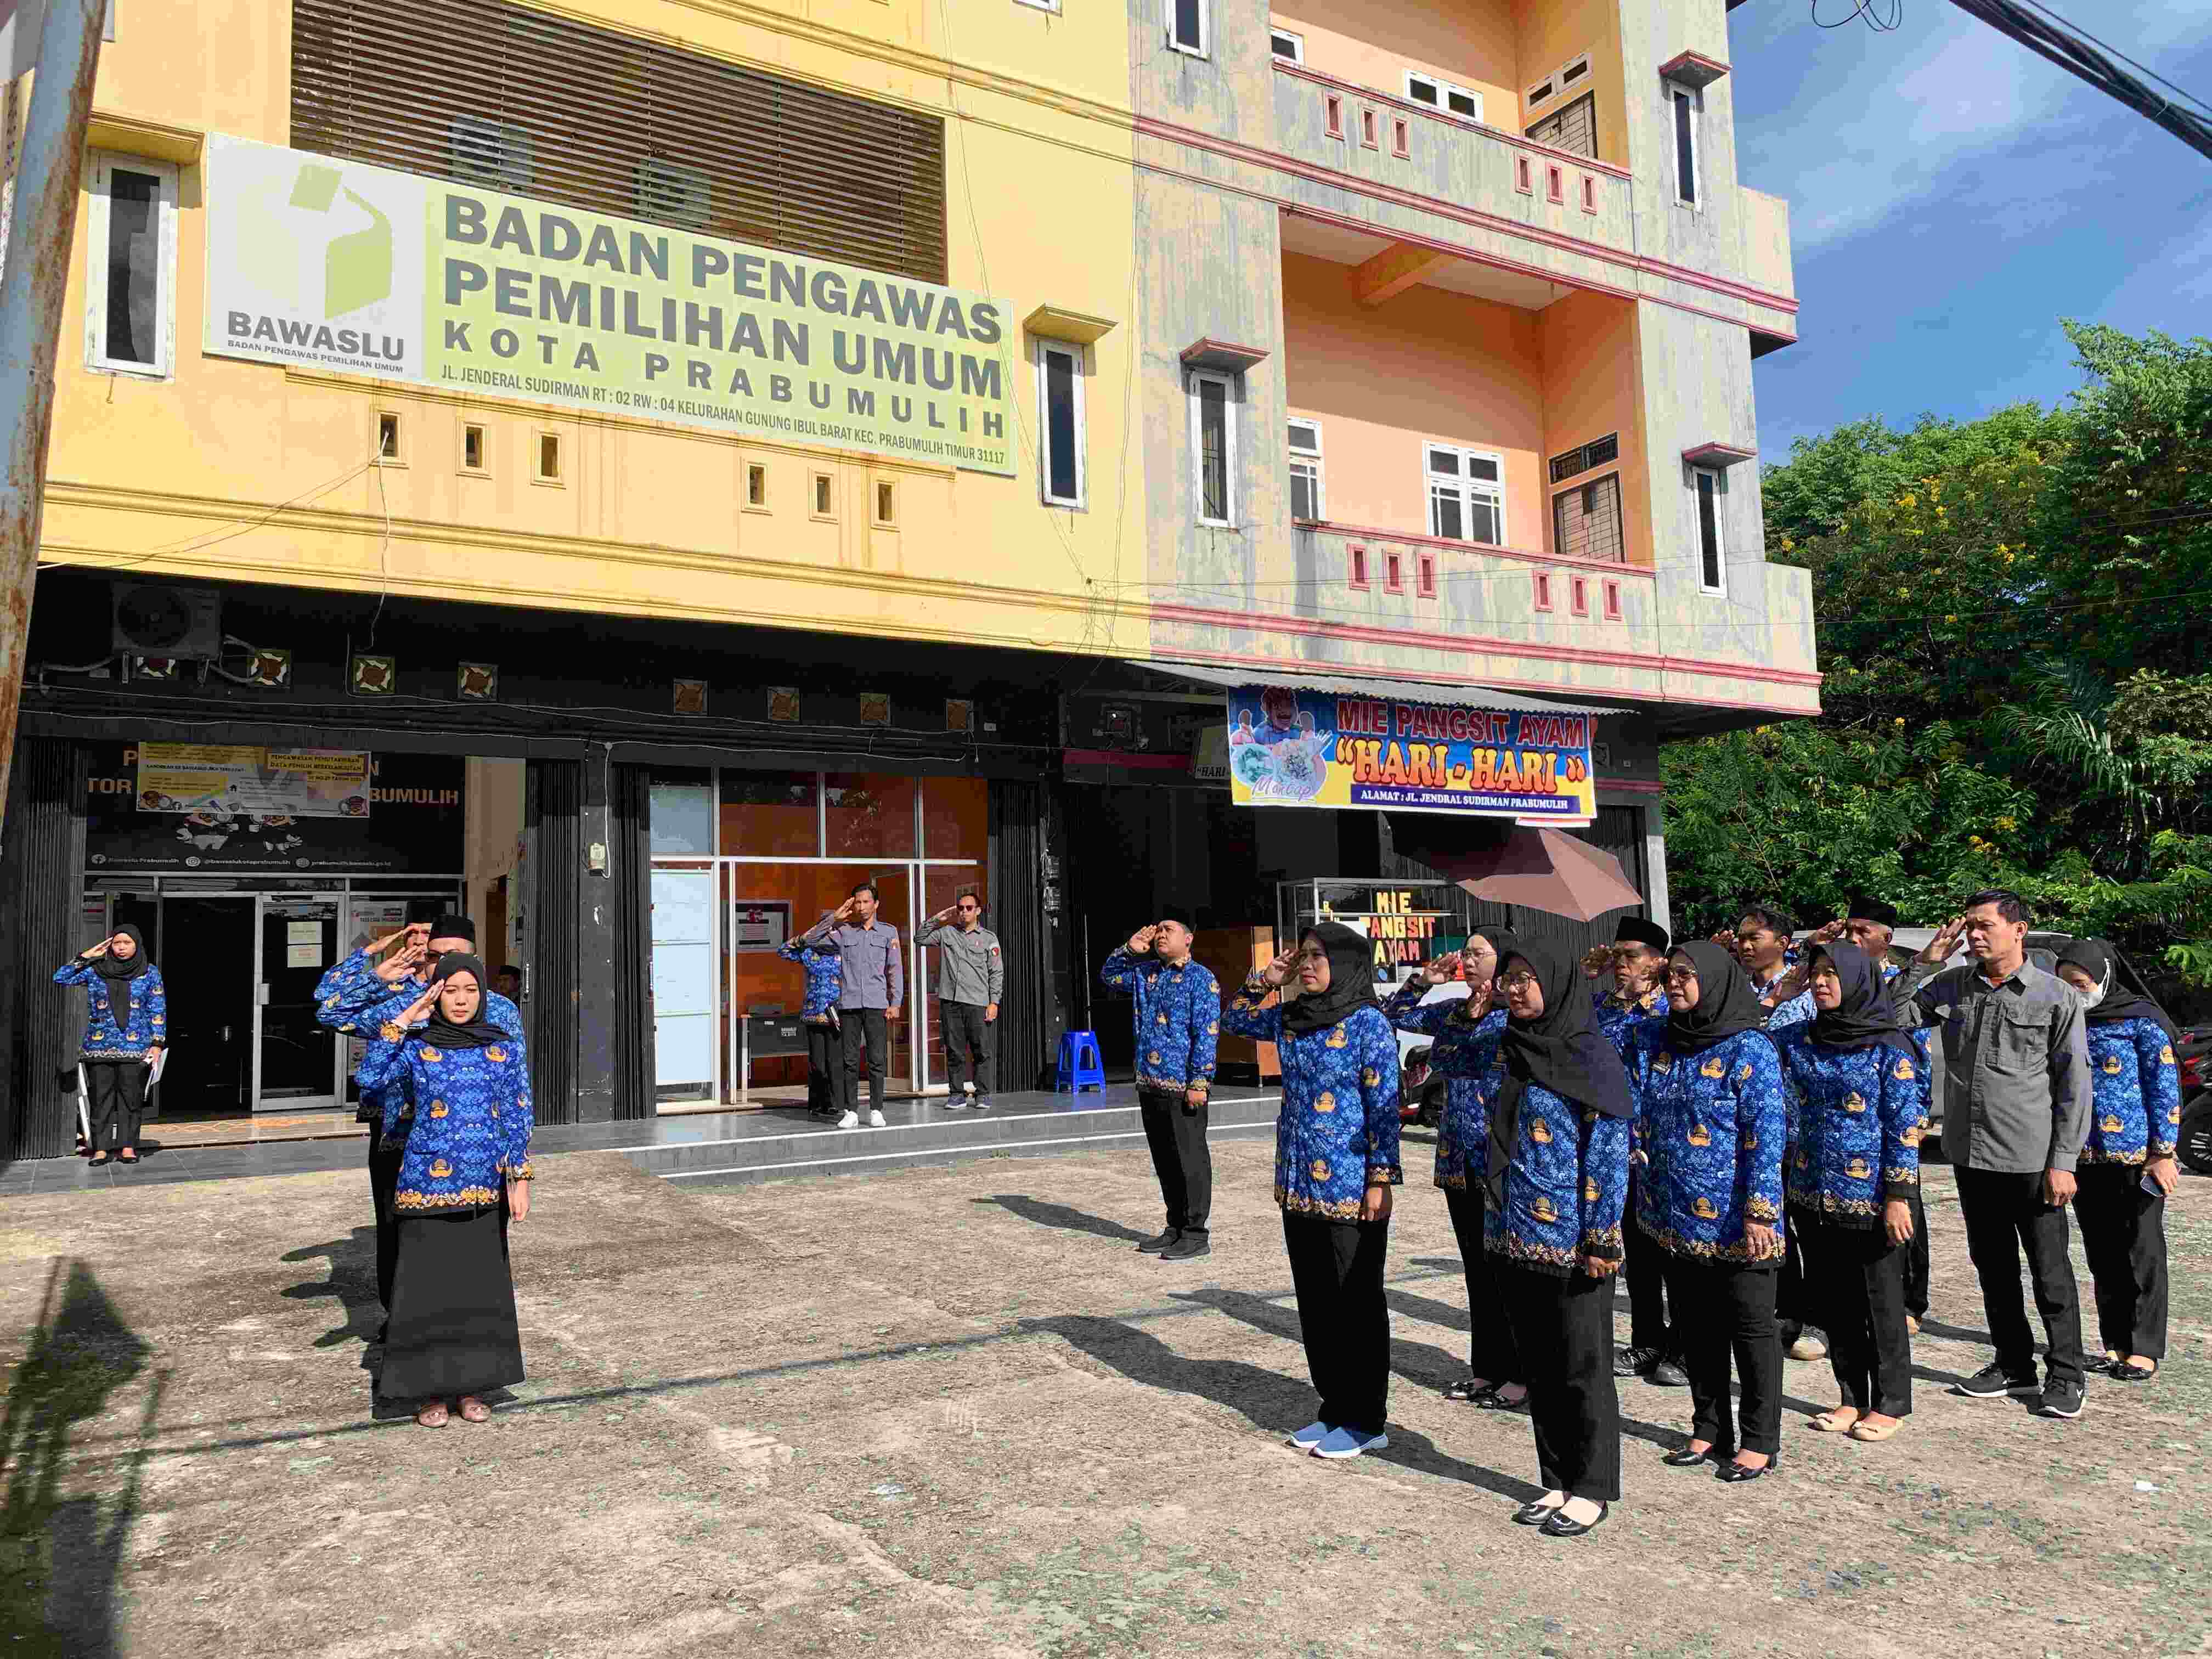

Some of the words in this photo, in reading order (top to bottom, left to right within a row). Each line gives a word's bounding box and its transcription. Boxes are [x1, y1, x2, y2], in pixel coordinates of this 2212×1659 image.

[445, 194, 668, 280] BADAN
[692, 244, 1001, 344] PENGAWAS
[228, 311, 404, 360] BAWASLU
[445, 258, 809, 366] PEMILIHAN
[833, 330, 1001, 400] UMUM
[228, 340, 262, 352] BADAN
[264, 343, 318, 360] PENGAWAS
[320, 354, 372, 368] PEMILIHAN
[374, 363, 403, 373] UMUM
[445, 320, 600, 371] KOTA
[645, 352, 1003, 438] PRABUMULIH
[442, 364, 458, 381] JL.
[461, 367, 522, 390] JENDERAL
[525, 377, 589, 400] SUDIRMAN
[592, 388, 607, 402] RT
[616, 391, 630, 405] 02
[634, 394, 651, 409] RW
[661, 398, 675, 412] 04
[678, 400, 742, 424] KELURAHAN
[746, 411, 791, 431] GUNUNG
[794, 419, 817, 435] IBUL
[820, 423, 851, 441] BARAT
[855, 429, 877, 445] KEC.
[879, 433, 943, 455] PRABUMULIH
[945, 443, 975, 460] TIMUR
[977, 449, 1005, 464] 31117
[1336, 698, 1389, 736] MIE
[1396, 706, 1510, 744] PANGSIT
[1516, 715, 1585, 749] AYAM
[1361, 789, 1400, 803] ALAMAT
[1406, 793, 1418, 804] JL.
[1419, 793, 1461, 806] JENDRAL
[1463, 795, 1510, 808] SUDIRMAN
[1511, 797, 1568, 810] PRABUMULIH
[1376, 891, 1413, 913] MIE
[1374, 939, 1421, 966] AYAM
